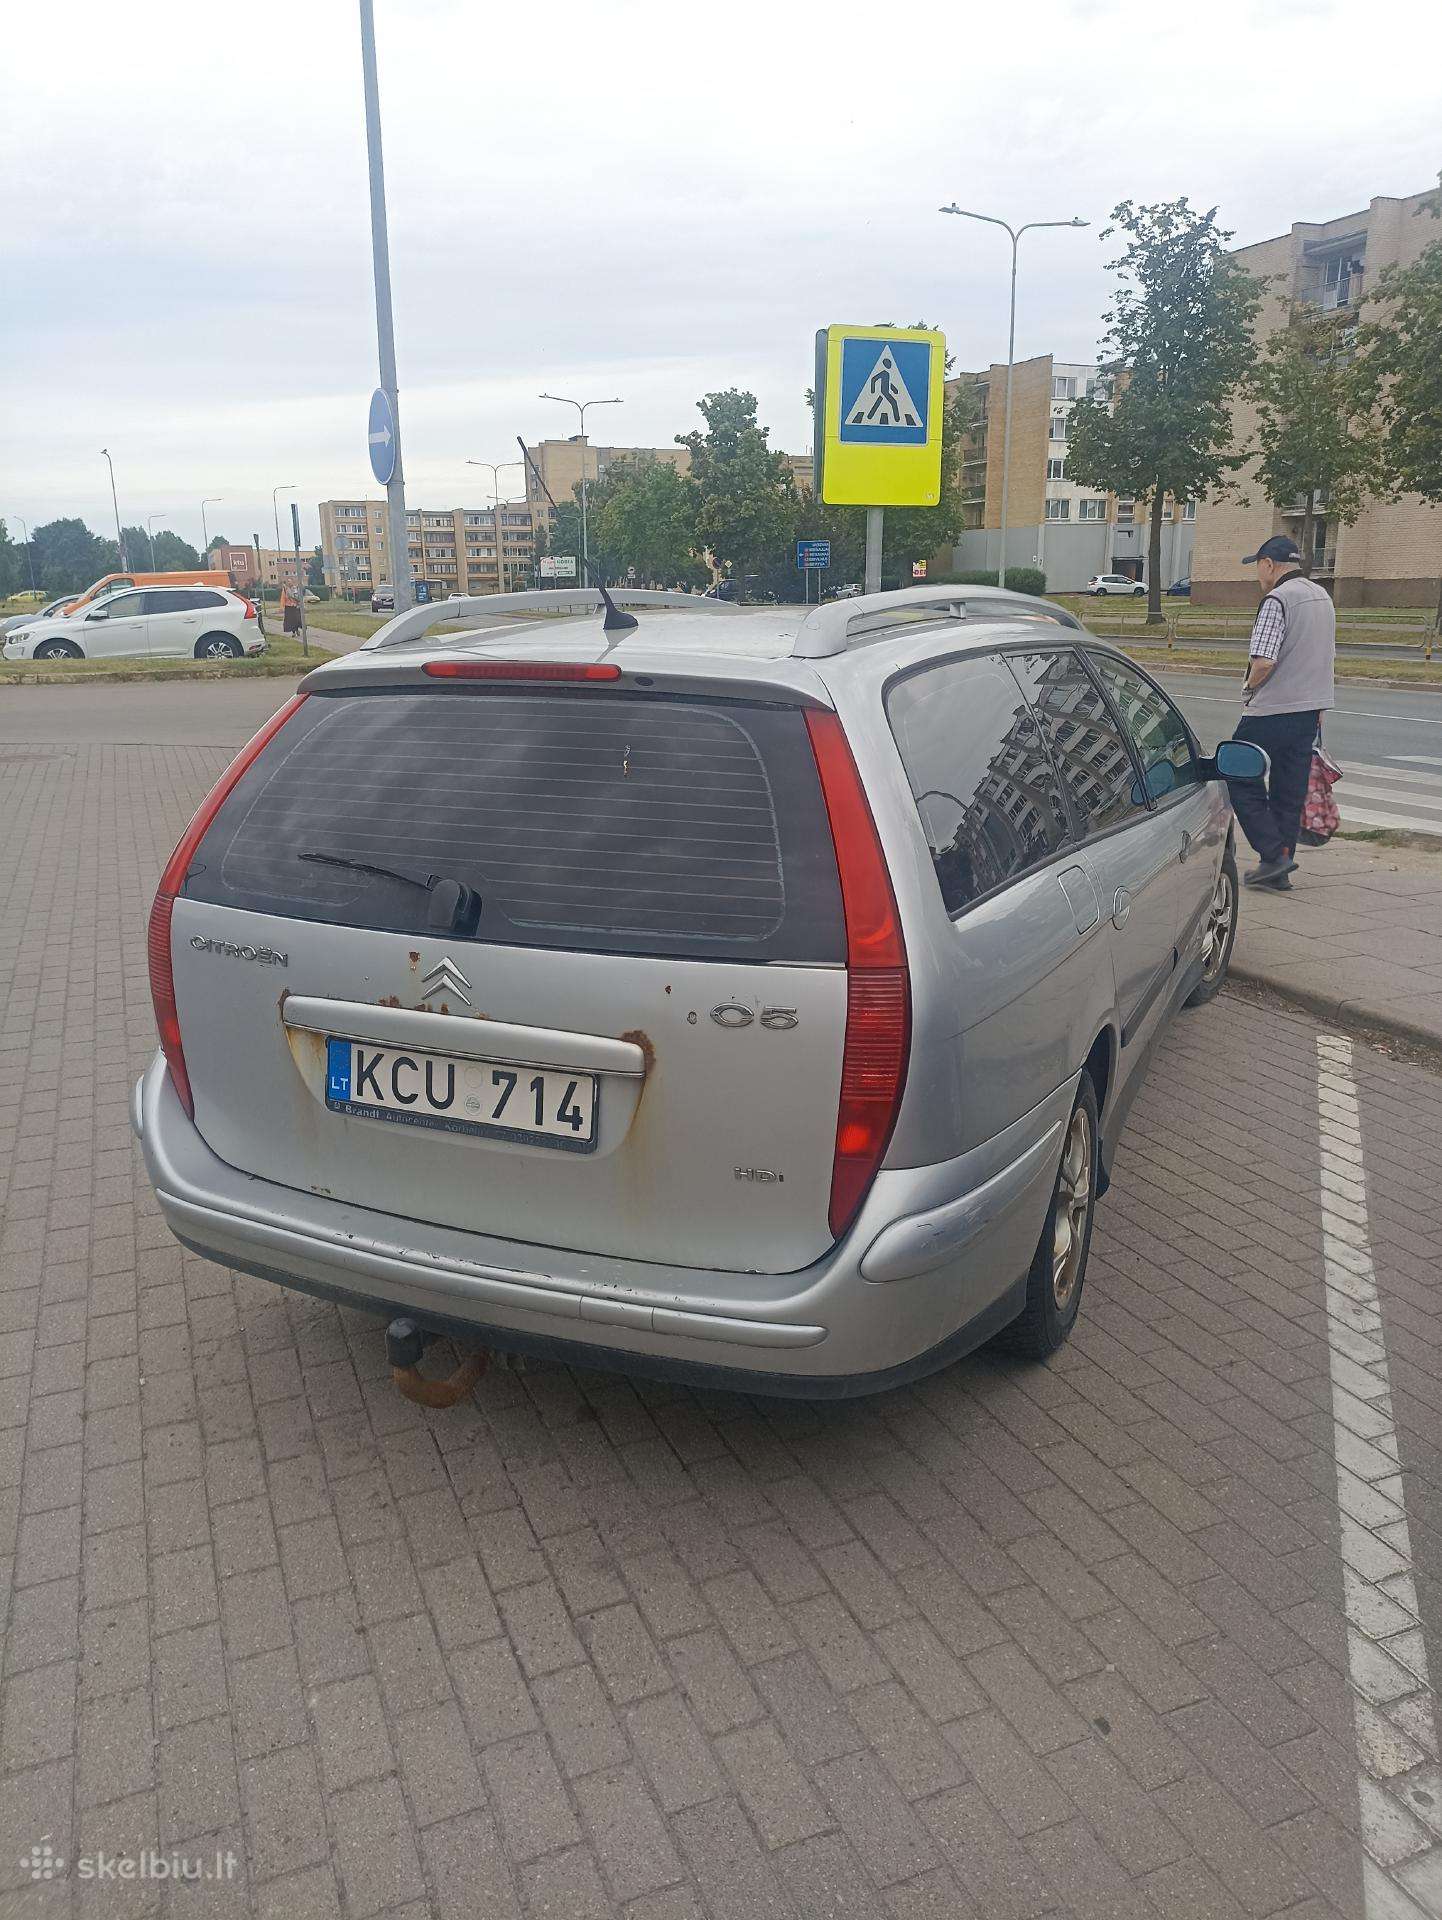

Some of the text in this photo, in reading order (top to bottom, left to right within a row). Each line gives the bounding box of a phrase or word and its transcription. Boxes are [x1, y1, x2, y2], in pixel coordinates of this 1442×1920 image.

[190, 935, 288, 967] CITROËN
[710, 1002, 799, 1029] C5
[331, 1076, 348, 1091] LT
[356, 1050, 584, 1131] KCU 714
